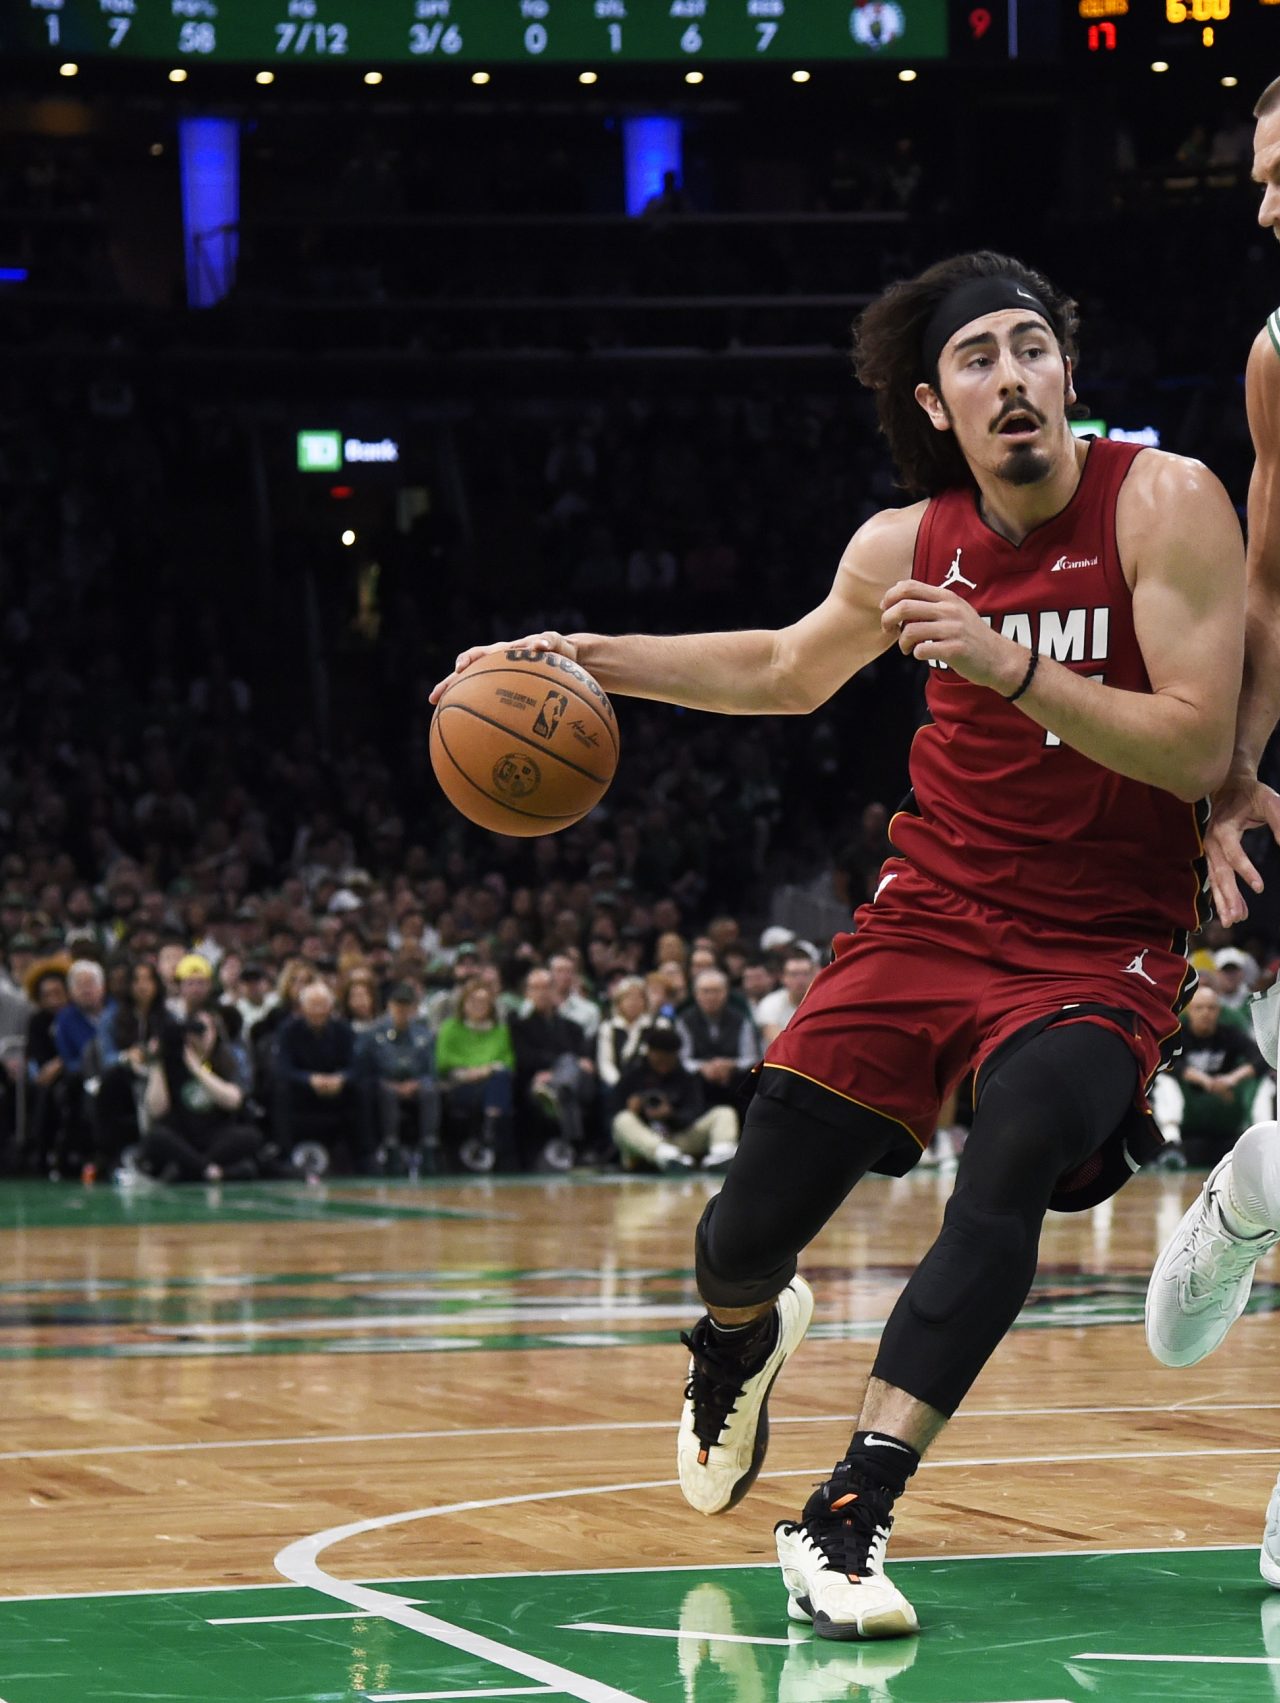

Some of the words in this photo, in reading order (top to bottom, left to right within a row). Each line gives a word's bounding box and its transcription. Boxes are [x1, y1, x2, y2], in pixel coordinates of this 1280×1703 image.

[45, 13, 60, 45] 1
[108, 17, 131, 48] 7
[275, 22, 348, 55] 7/12
[409, 22, 463, 55] 3/6
[524, 23, 548, 55] 0
[608, 23, 622, 53] 1
[680, 23, 703, 54] 6
[755, 22, 779, 52] 7
[1061, 555, 1098, 570] Carnival
[925, 606, 1111, 670] AMI
